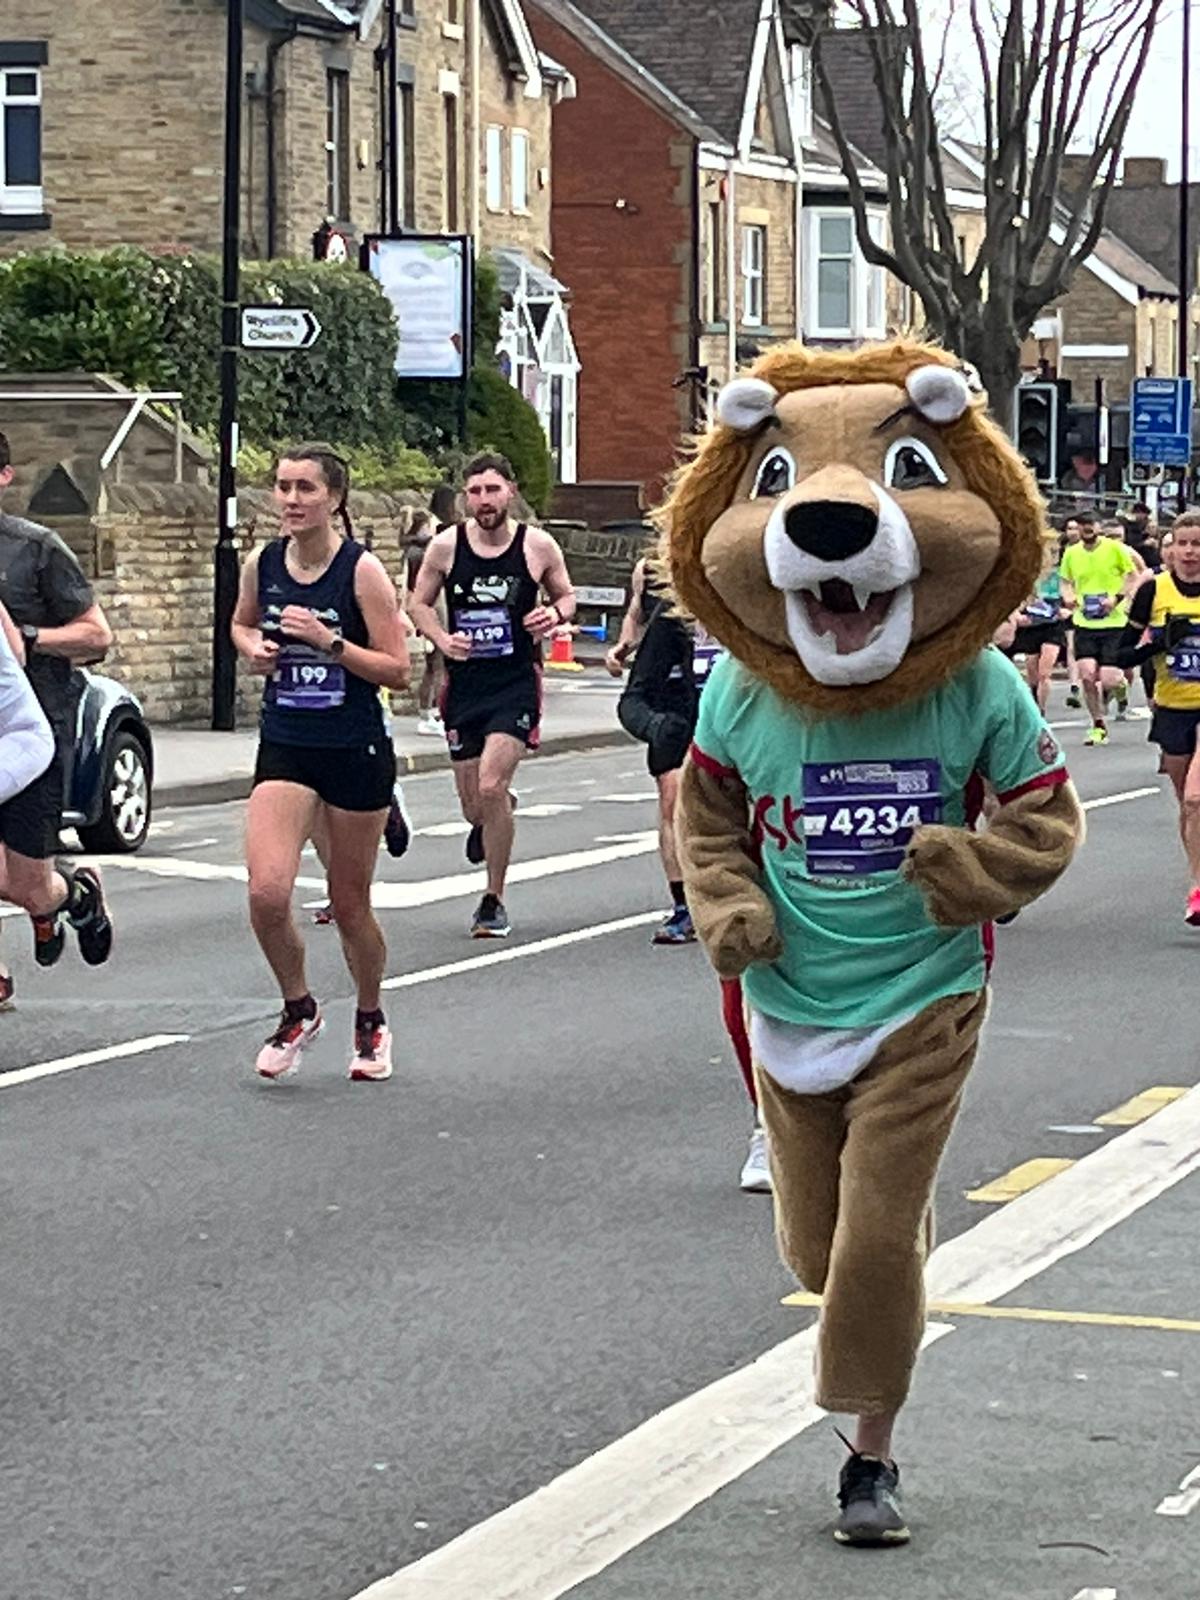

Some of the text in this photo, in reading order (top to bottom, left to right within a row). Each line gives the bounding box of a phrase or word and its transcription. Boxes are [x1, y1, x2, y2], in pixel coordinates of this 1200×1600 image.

[248, 328, 295, 341] Church
[291, 665, 328, 684] 199
[830, 805, 922, 836] 4234
